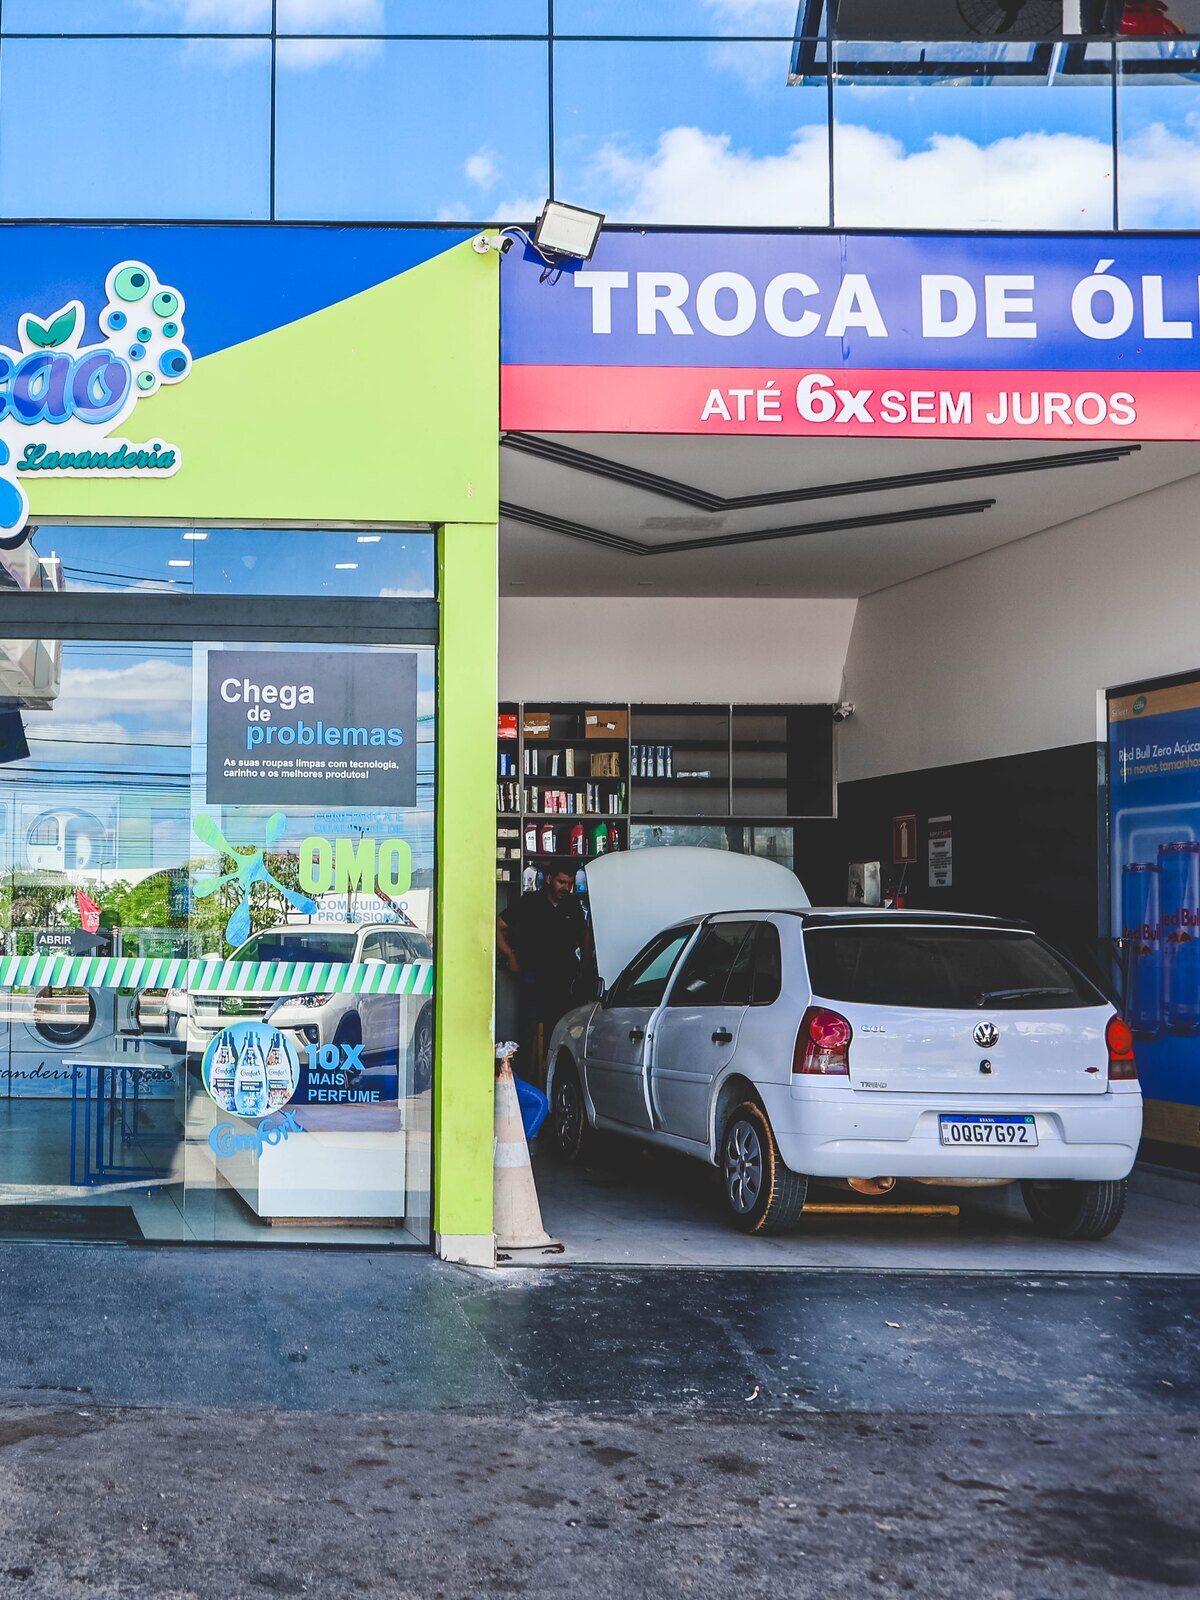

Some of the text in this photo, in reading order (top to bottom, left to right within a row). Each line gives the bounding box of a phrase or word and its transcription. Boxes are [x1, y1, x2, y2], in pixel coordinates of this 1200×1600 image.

[573, 259, 1200, 341] TROCA DE ÓL
[700, 373, 1137, 426] ATÉ 6x SEM JUROS
[17, 443, 177, 472] Lavanderia
[220, 678, 315, 709] Chega
[247, 705, 271, 722] de
[247, 721, 404, 749] problemas
[1119, 740, 1200, 761] Red Bull Zero Açúca
[223, 758, 237, 767] As
[262, 760, 293, 769] roupas
[296, 758, 326, 770] limpas
[350, 759, 399, 771] tecnologia,
[223, 768, 258, 778] carinho
[281, 769, 323, 779] melhores
[325, 769, 369, 780] produtos!
[299, 836, 412, 896] OMO
[319, 901, 408, 911] COM CUIDADO
[39, 935, 71, 945] ABRIR
[861, 1025, 886, 1033] GOL
[304, 1043, 366, 1070] 10X
[308, 1072, 346, 1086] MAIS
[860, 1081, 888, 1089] TREND
[308, 1089, 380, 1103] PERFUME
[208, 1109, 305, 1159] Comfort
